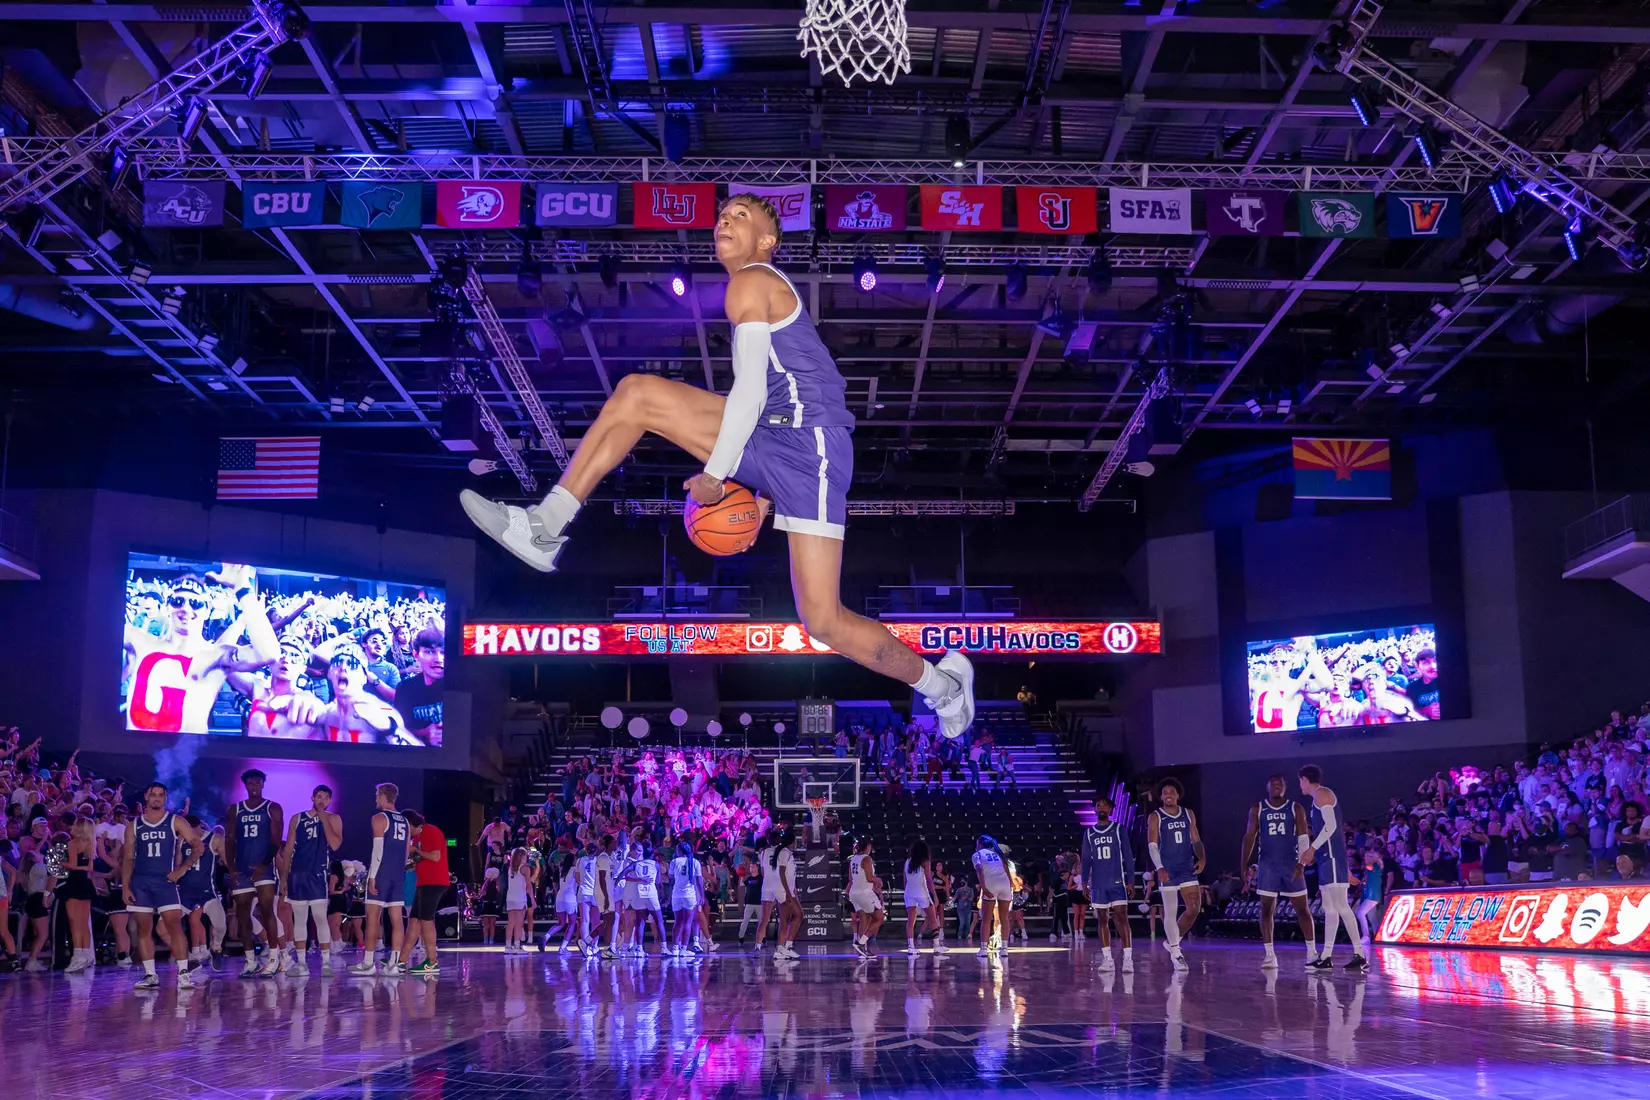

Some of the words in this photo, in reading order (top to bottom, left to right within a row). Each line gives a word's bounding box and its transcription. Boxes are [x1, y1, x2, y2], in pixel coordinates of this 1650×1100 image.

[254, 192, 311, 215] CBU
[541, 192, 612, 218] GCU
[163, 199, 205, 223] ACU
[838, 218, 861, 228] NM
[862, 217, 892, 228] STATE
[728, 510, 757, 523] ELITE
[625, 626, 717, 641] FOLLOW
[648, 638, 668, 653] US
[671, 639, 693, 653] AT:
[241, 814, 261, 823] GCU
[1266, 812, 1286, 821] GCU
[243, 823, 258, 838] 13
[393, 821, 406, 840] 15
[1167, 821, 1186, 830] GCU
[1268, 822, 1286, 836] 24
[141, 831, 166, 841] GCU
[306, 827, 318, 839] 31
[1174, 831, 1183, 844] 0
[1094, 836, 1113, 846] GCU
[147, 842, 161, 857] 11
[1097, 846, 1111, 859] 10
[986, 852, 1000, 862] 32
[680, 865, 687, 875] 3
[1418, 896, 1505, 921] FOLLOW
[807, 927, 827, 936] GCU
[1427, 920, 1445, 941] US
[1447, 920, 1472, 942] AT:
